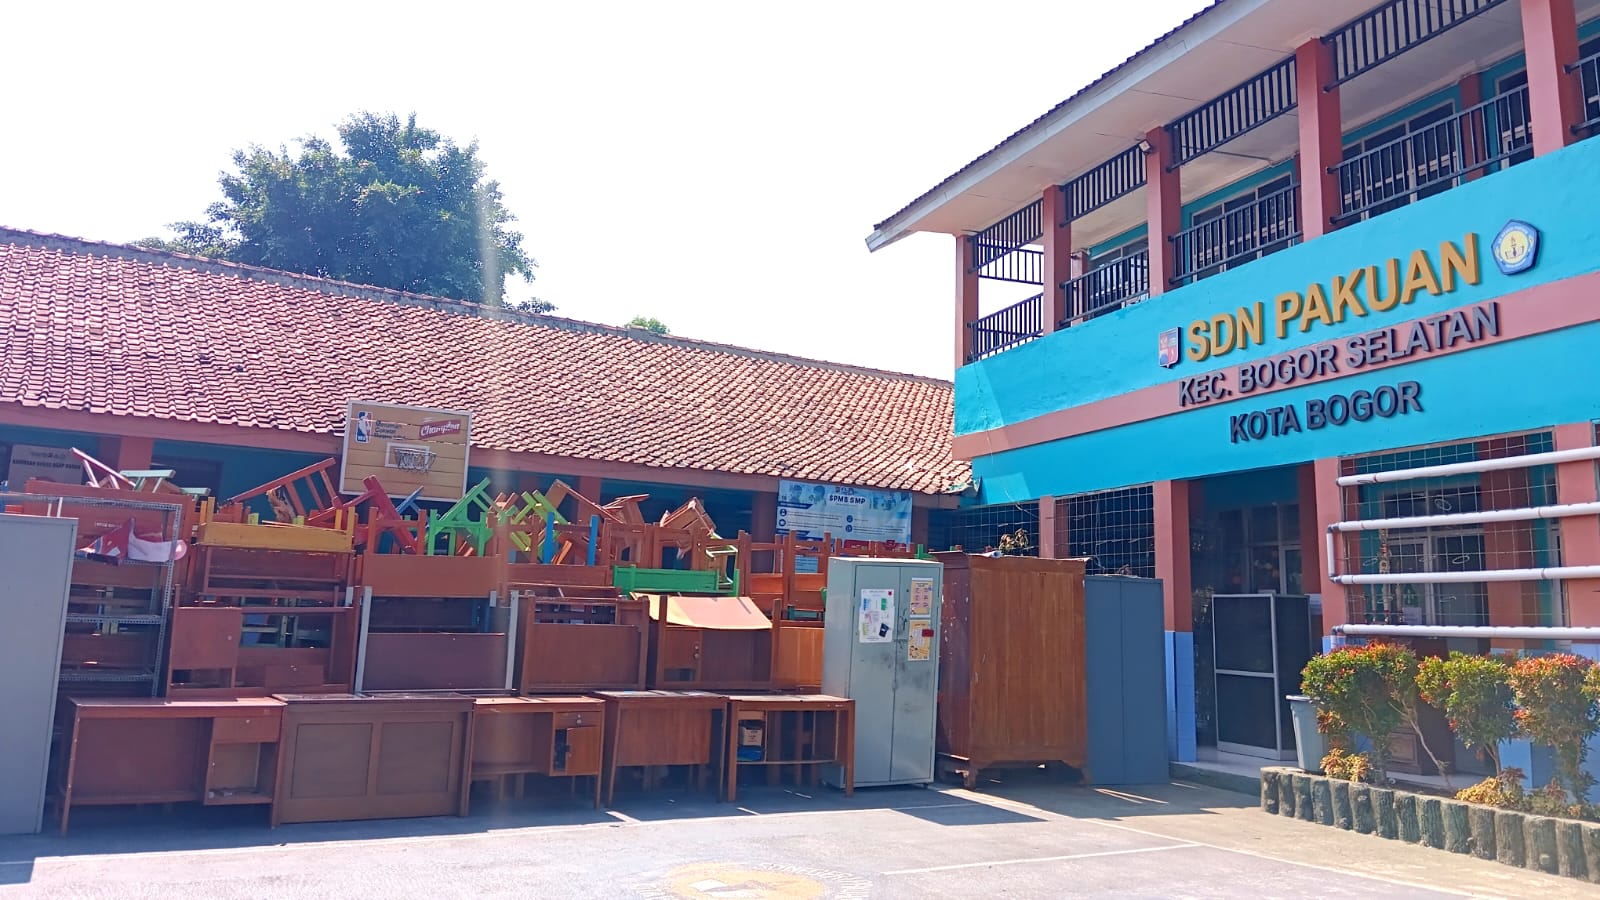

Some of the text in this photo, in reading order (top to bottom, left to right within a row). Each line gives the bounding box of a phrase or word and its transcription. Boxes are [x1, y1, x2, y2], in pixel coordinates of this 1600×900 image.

[1187, 302, 1263, 362] SDN
[1275, 232, 1480, 339] PAKUAN
[1178, 302, 1500, 407] KEC. BOGOR SELATAN
[1229, 380, 1425, 444] KOTA BOGOR
[849, 496, 866, 505] SMP
